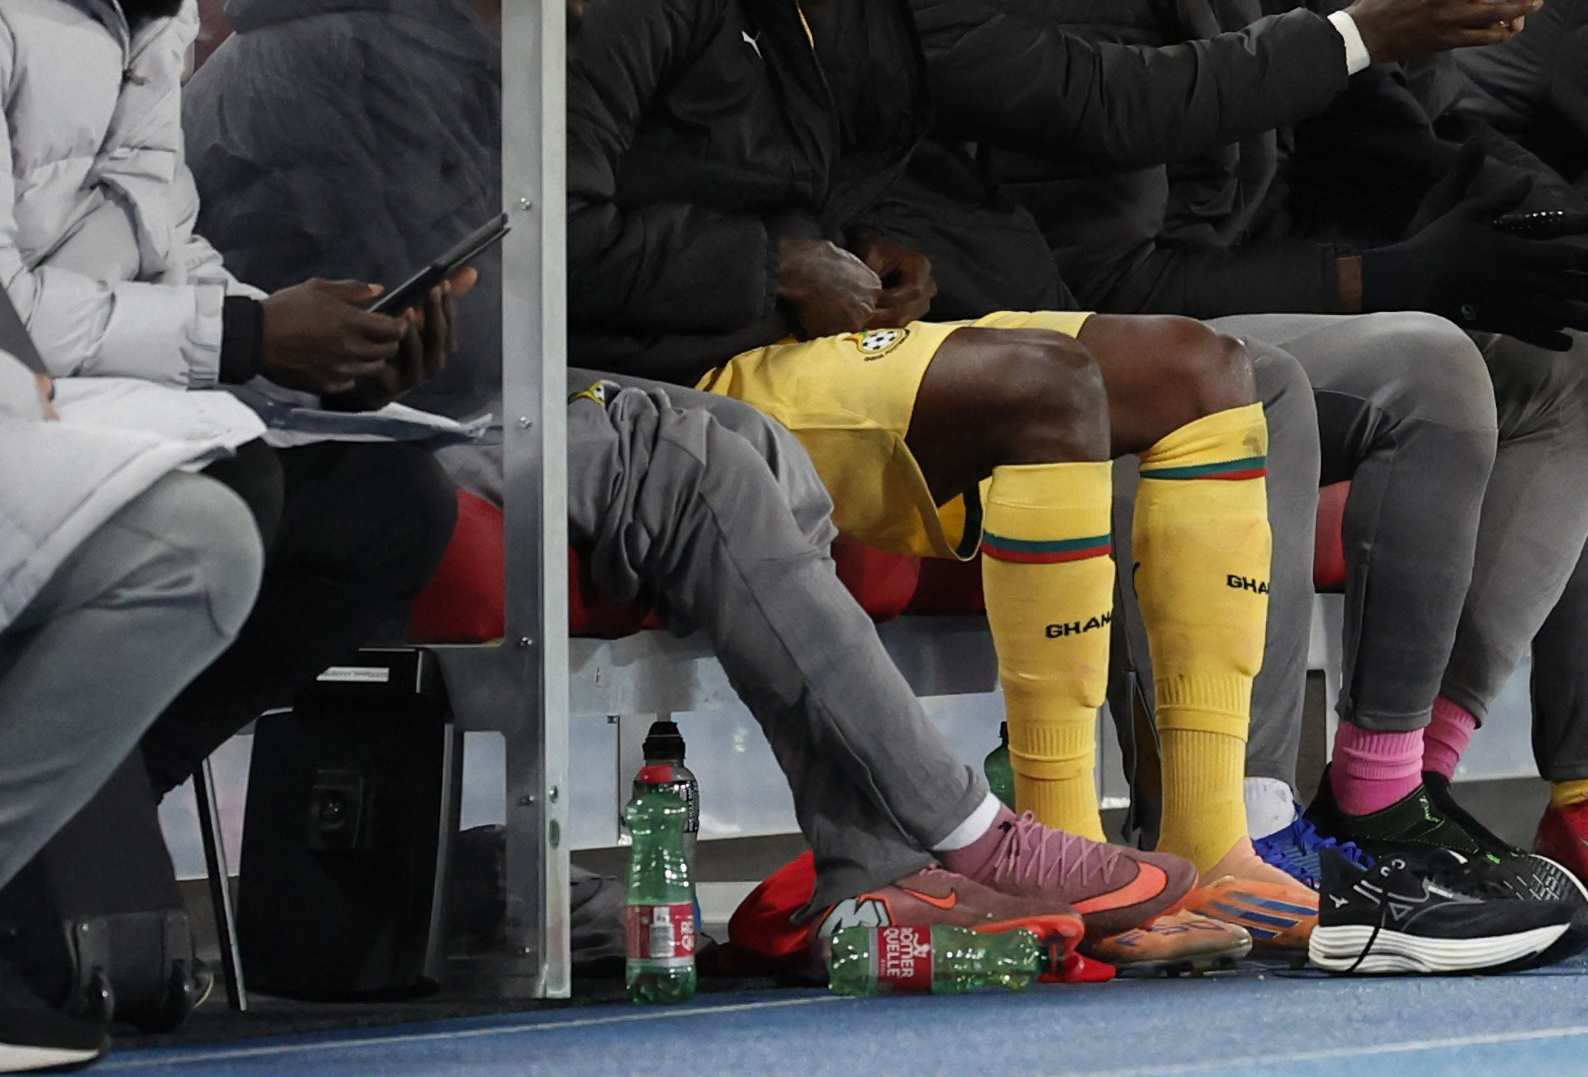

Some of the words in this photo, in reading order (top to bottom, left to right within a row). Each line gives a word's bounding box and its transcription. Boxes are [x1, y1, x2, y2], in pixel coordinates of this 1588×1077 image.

[1226, 574, 1270, 594] GHA
[1045, 611, 1113, 639] GHAN
[883, 927, 900, 978] QUELLE
